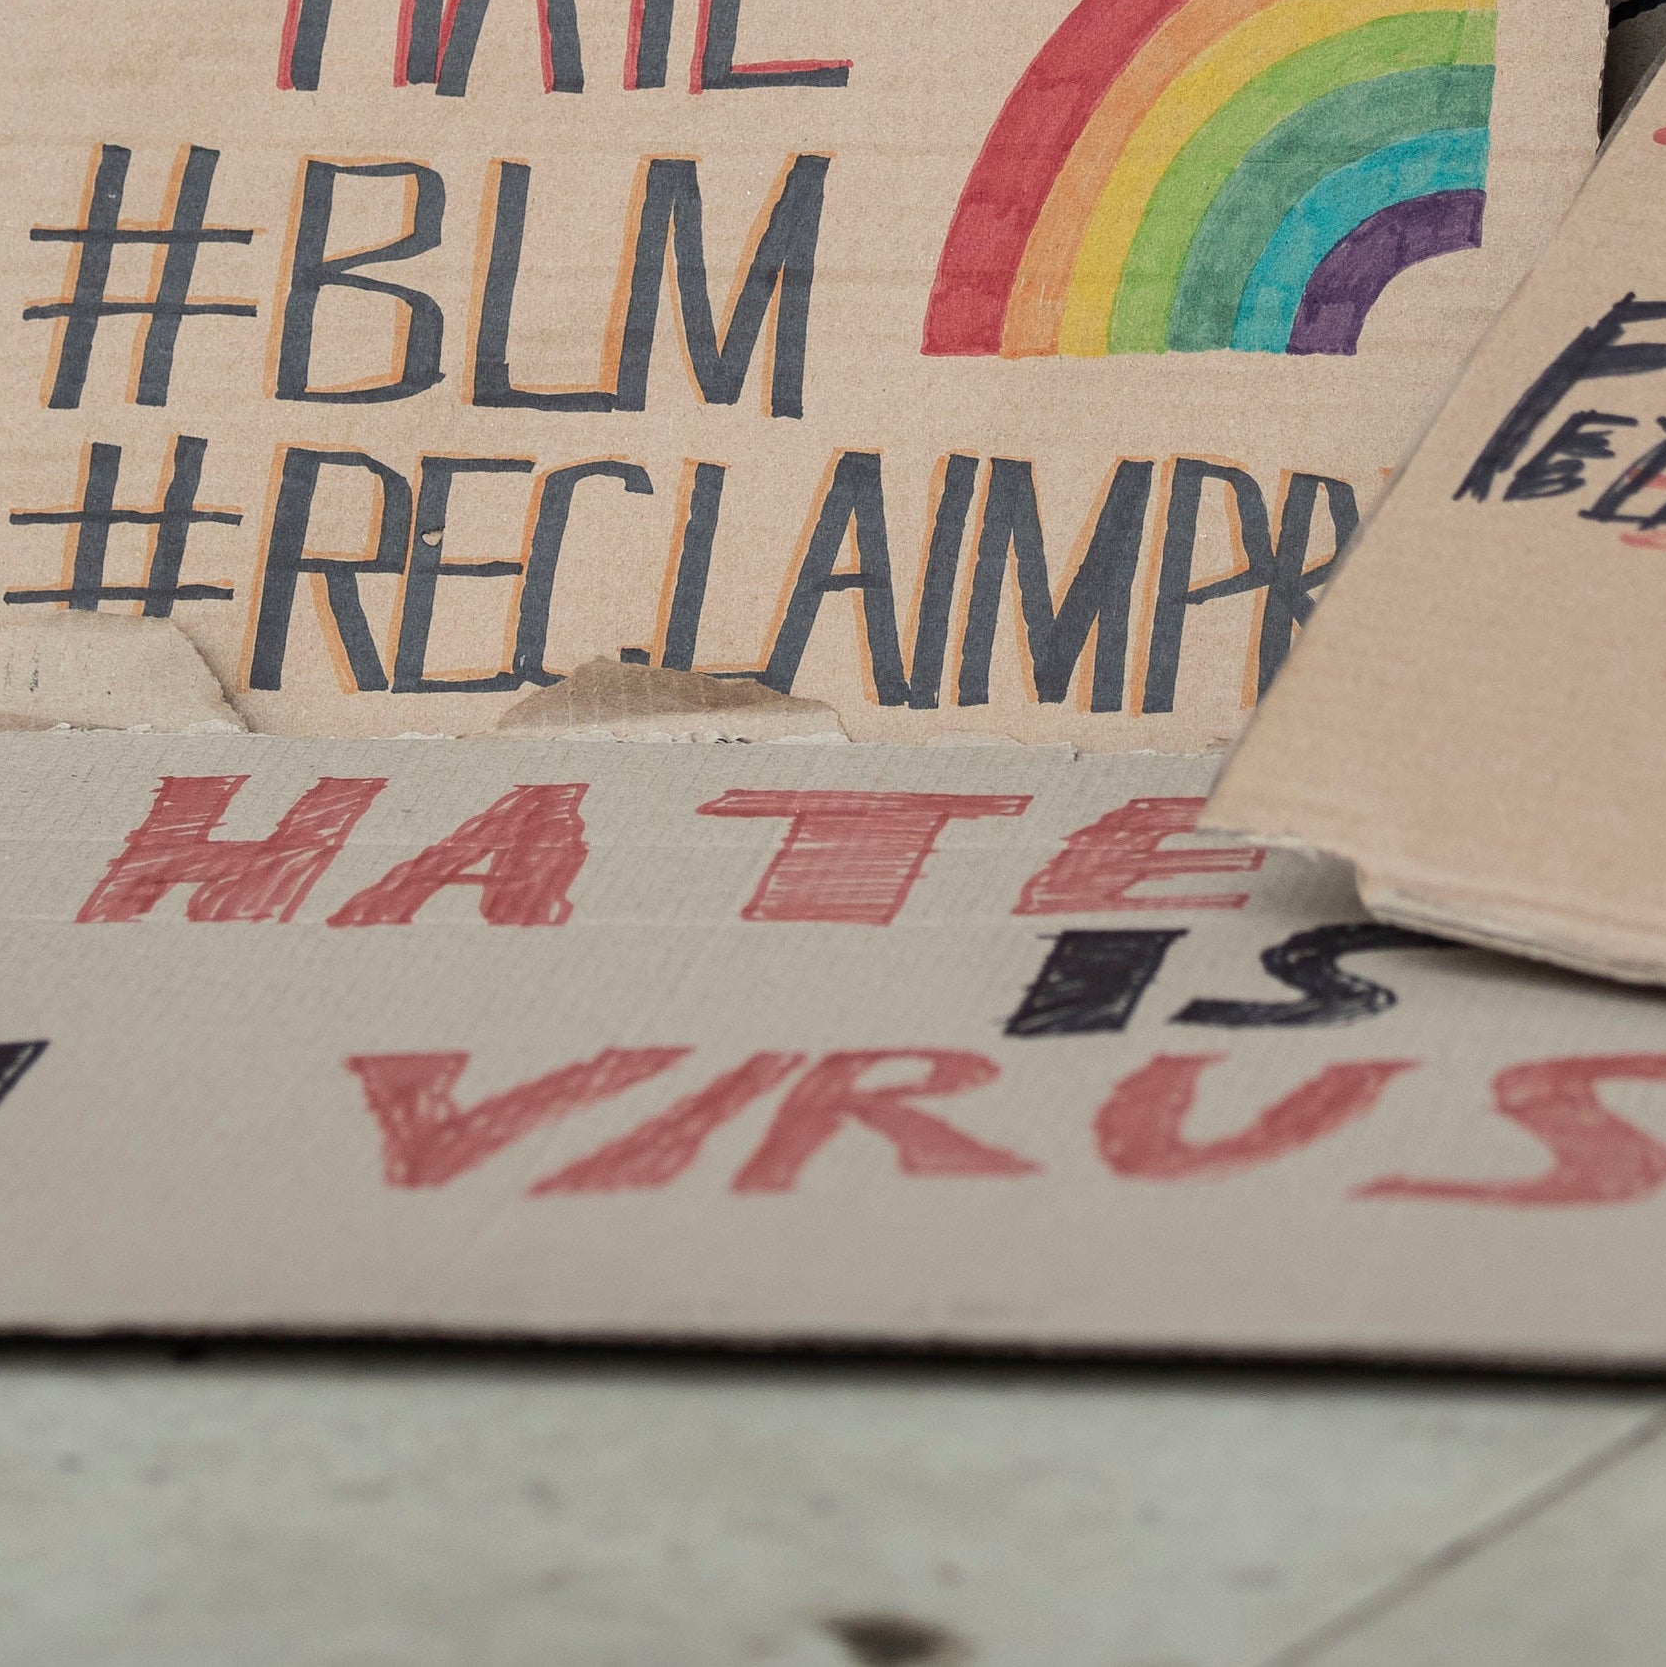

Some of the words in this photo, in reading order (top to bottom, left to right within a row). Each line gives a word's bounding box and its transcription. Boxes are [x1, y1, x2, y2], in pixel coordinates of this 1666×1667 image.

[23, 143, 835, 418] #BLM
[74, 775, 1266, 926] HATE
[1003, 923, 1458, 1036] IS
